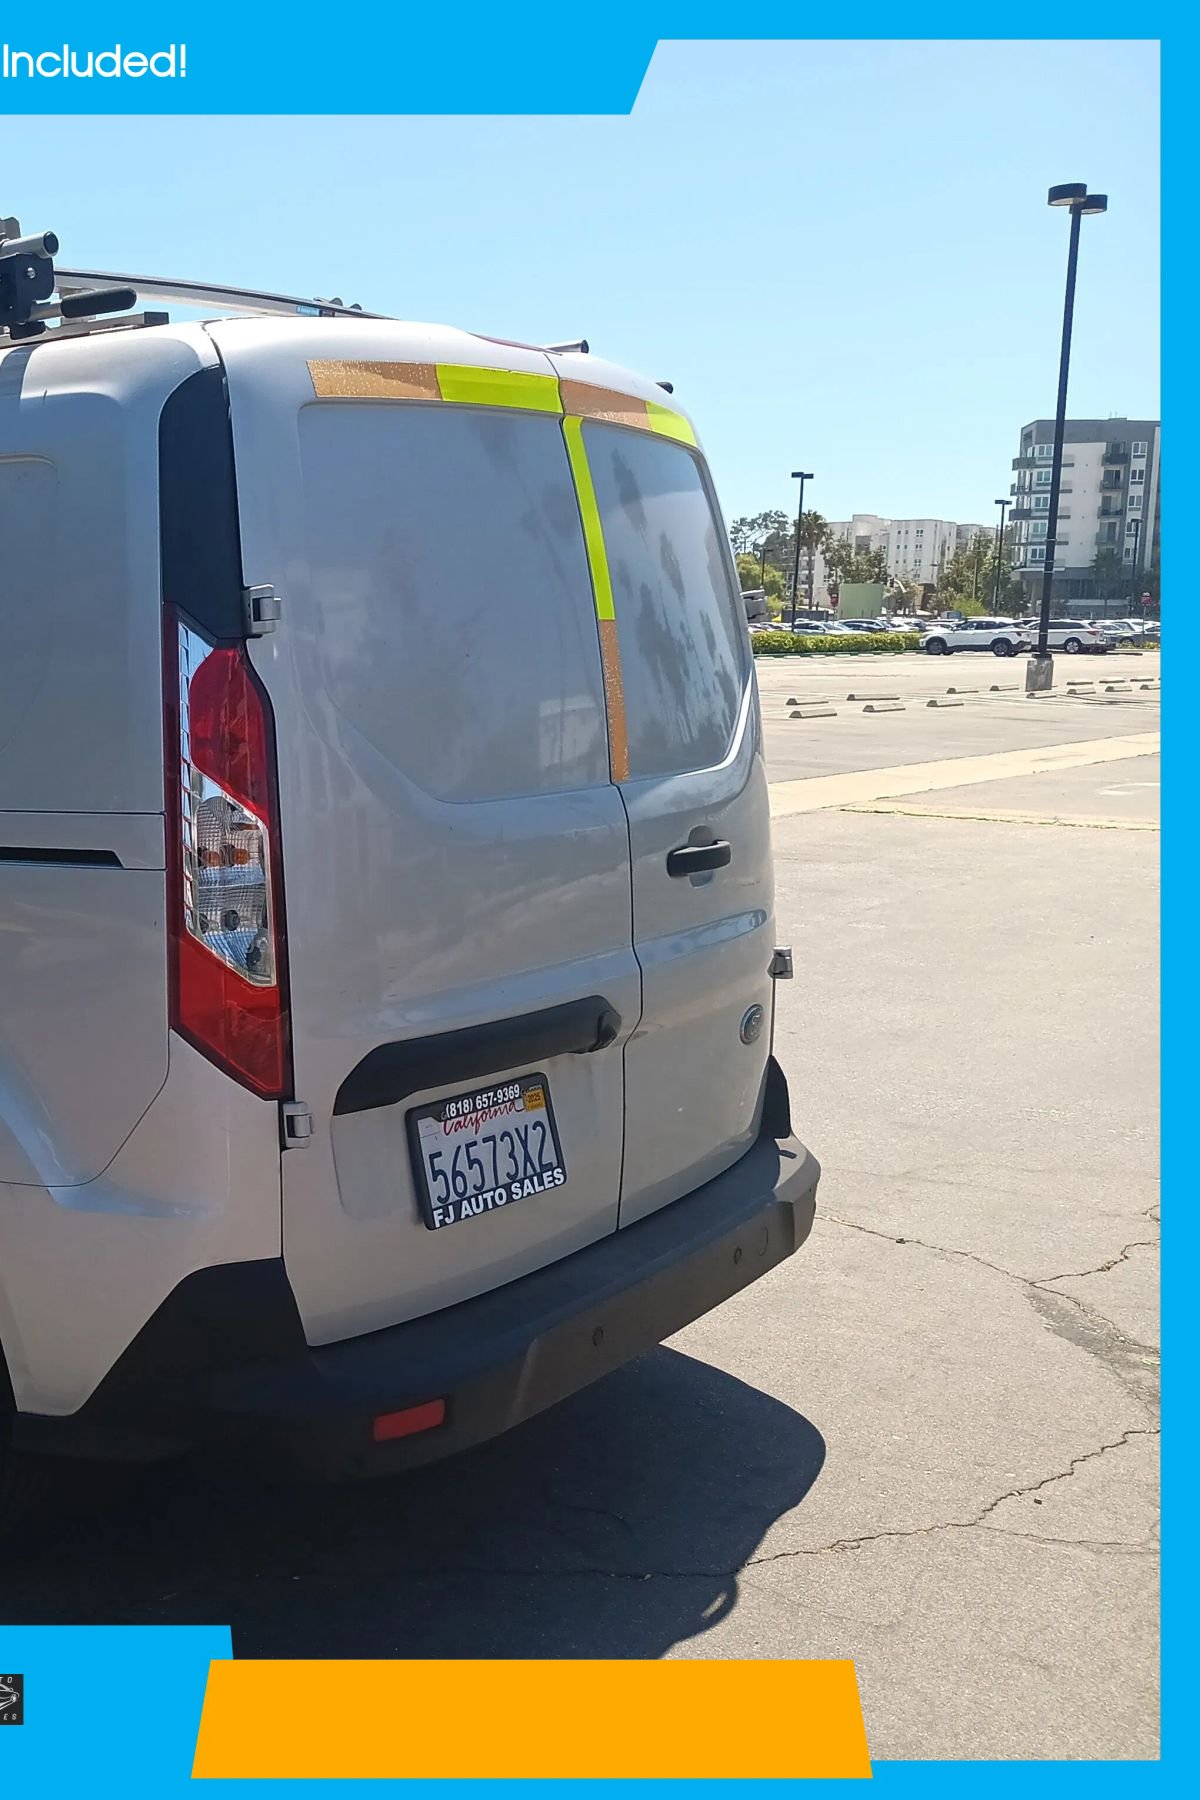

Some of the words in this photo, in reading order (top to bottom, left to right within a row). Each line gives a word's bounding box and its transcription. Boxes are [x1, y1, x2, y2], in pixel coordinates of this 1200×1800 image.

[442, 1100, 525, 1136] California
[445, 1097, 473, 1118] (818)
[475, 1083, 520, 1110] 657-9369
[428, 1120, 553, 1204] 56573X2
[433, 1206, 454, 1228] FJ
[460, 1187, 507, 1219] AUTO
[511, 1168, 565, 1200] SALES
